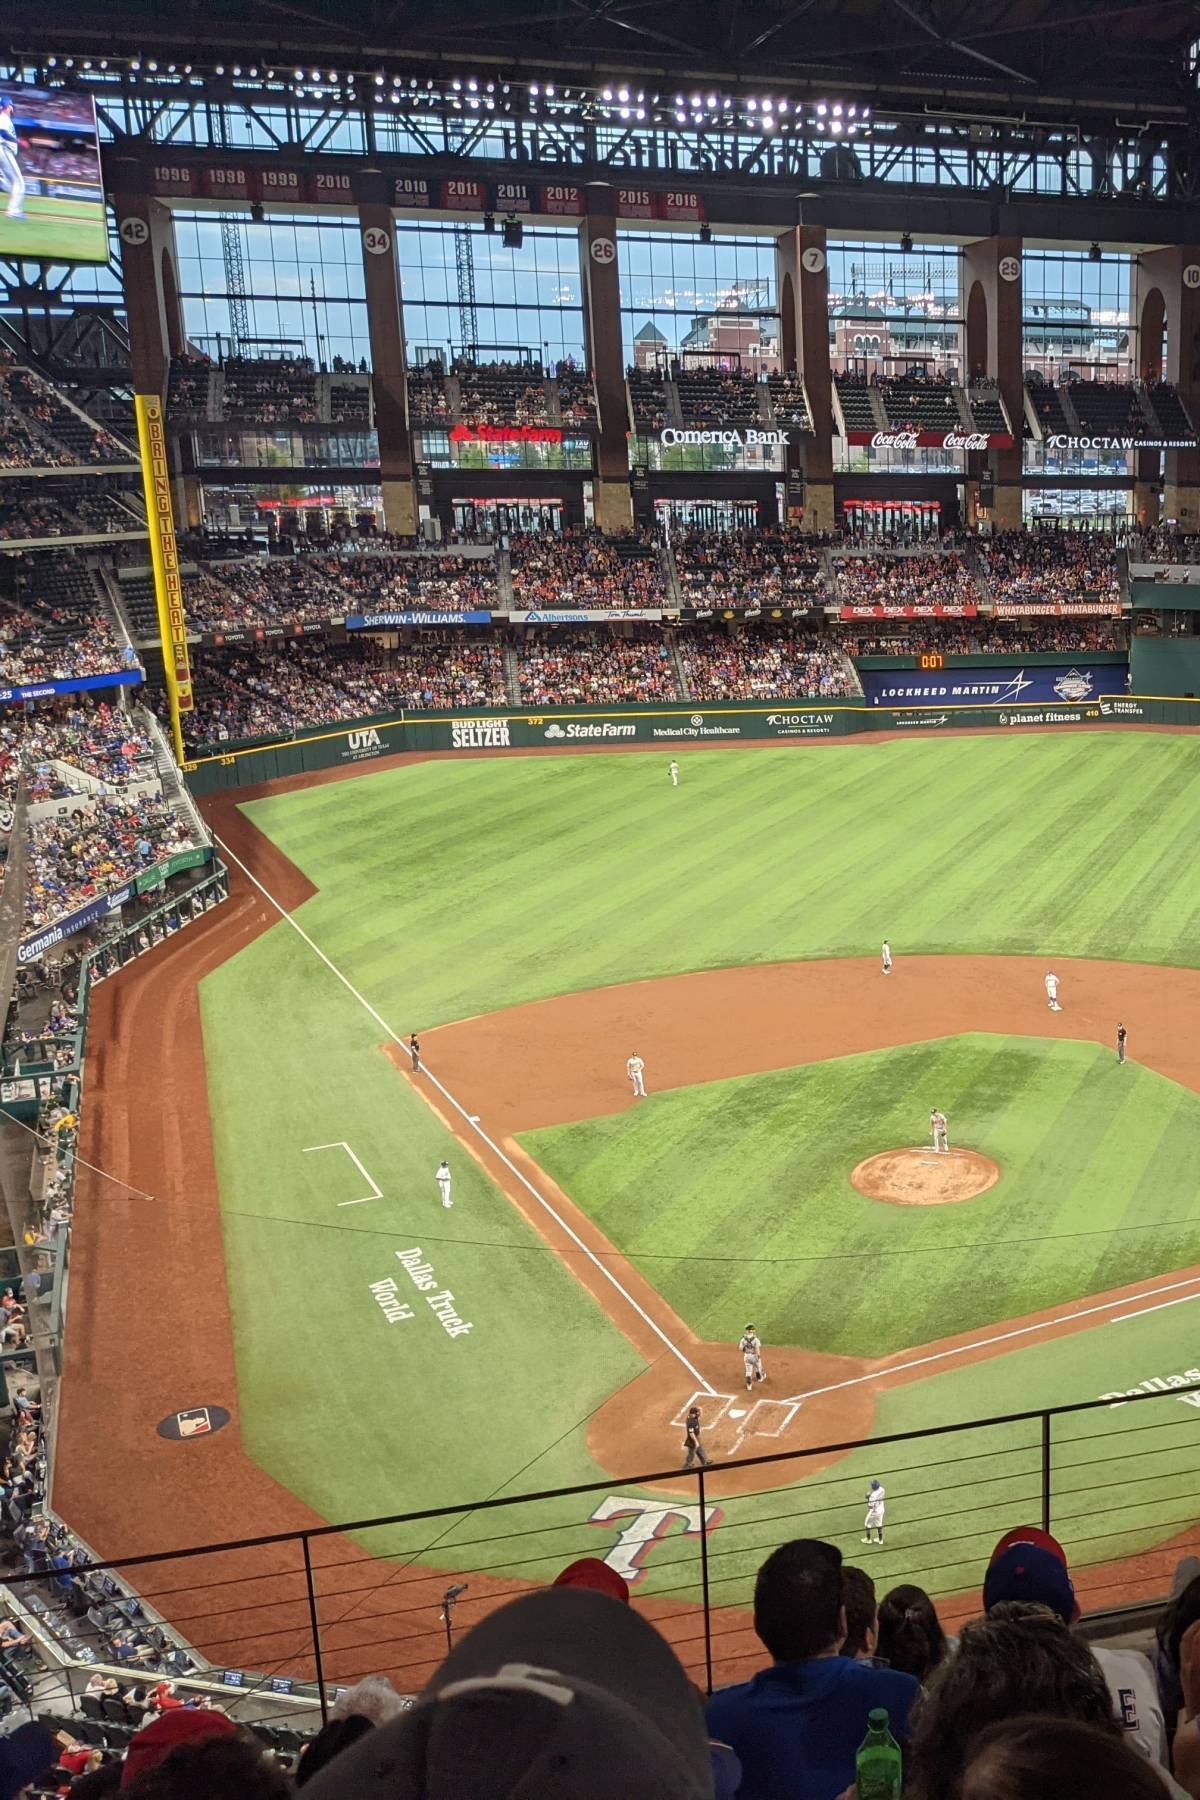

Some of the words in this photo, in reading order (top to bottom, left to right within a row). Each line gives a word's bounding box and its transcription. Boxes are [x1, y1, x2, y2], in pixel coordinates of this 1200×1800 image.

[154, 167, 190, 182] 1996
[210, 169, 246, 184] 1998
[262, 172, 298, 186] 1999
[316, 175, 350, 189] 2010
[395, 180, 428, 193] 2010
[448, 181, 478, 196] 2011
[497, 184, 527, 198] 2011
[546, 187, 578, 200] 2012
[619, 191, 649, 205] 2015
[667, 193, 697, 207] 2016
[123, 224, 145, 239] 42
[365, 234, 387, 249] 34
[593, 244, 613, 258] 26
[809, 253, 819, 267] 7
[1001, 261, 1019, 276] 29
[1186, 269, 1200, 283] 10
[477, 425, 520, 442] State
[521, 425, 562, 443] Farm
[745, 429, 790, 445] Bank
[1056, 435, 1134, 449] CHOCTAW
[151, 424, 168, 513] BRING
[161, 519, 175, 569] THE
[167, 577, 182, 643] HEAT
[607, 610, 621, 618] Tom
[622, 610, 646, 618] Thumb
[943, 605, 964, 613] DEX
[997, 605, 1056, 616] WHATABURGER
[1060, 603, 1117, 615] WHATABURGER
[542, 613, 588, 622] Albertsons
[32, 688, 56, 697] SECOND
[882, 686, 947, 697] LOCKHEED
[952, 685, 1000, 696] MARTIN
[452, 720, 477, 729] BUD
[478, 719, 509, 728] LIGHT
[774, 714, 834, 725] CHOCTAW
[1010, 713, 1042, 726] planet
[1045, 712, 1081, 722] fitness
[452, 727, 511, 748] SELTZER
[566, 724, 601, 739] State
[602, 723, 636, 737] Farm
[653, 728, 683, 737] Medical
[683, 727, 699, 737] City
[700, 726, 740, 735] Healthcare
[348, 728, 381, 750] UTA
[183, 763, 198, 772] 329
[220, 757, 236, 766] 334
[63, 910, 99, 937] INSURANCE
[18, 926, 63, 962] Germania
[395, 1247, 438, 1291] Dallas
[425, 1289, 474, 1339] Truck
[368, 1277, 415, 1324] World
[588, 1495, 723, 1586] T
[1117, 1688, 1140, 1731] E
